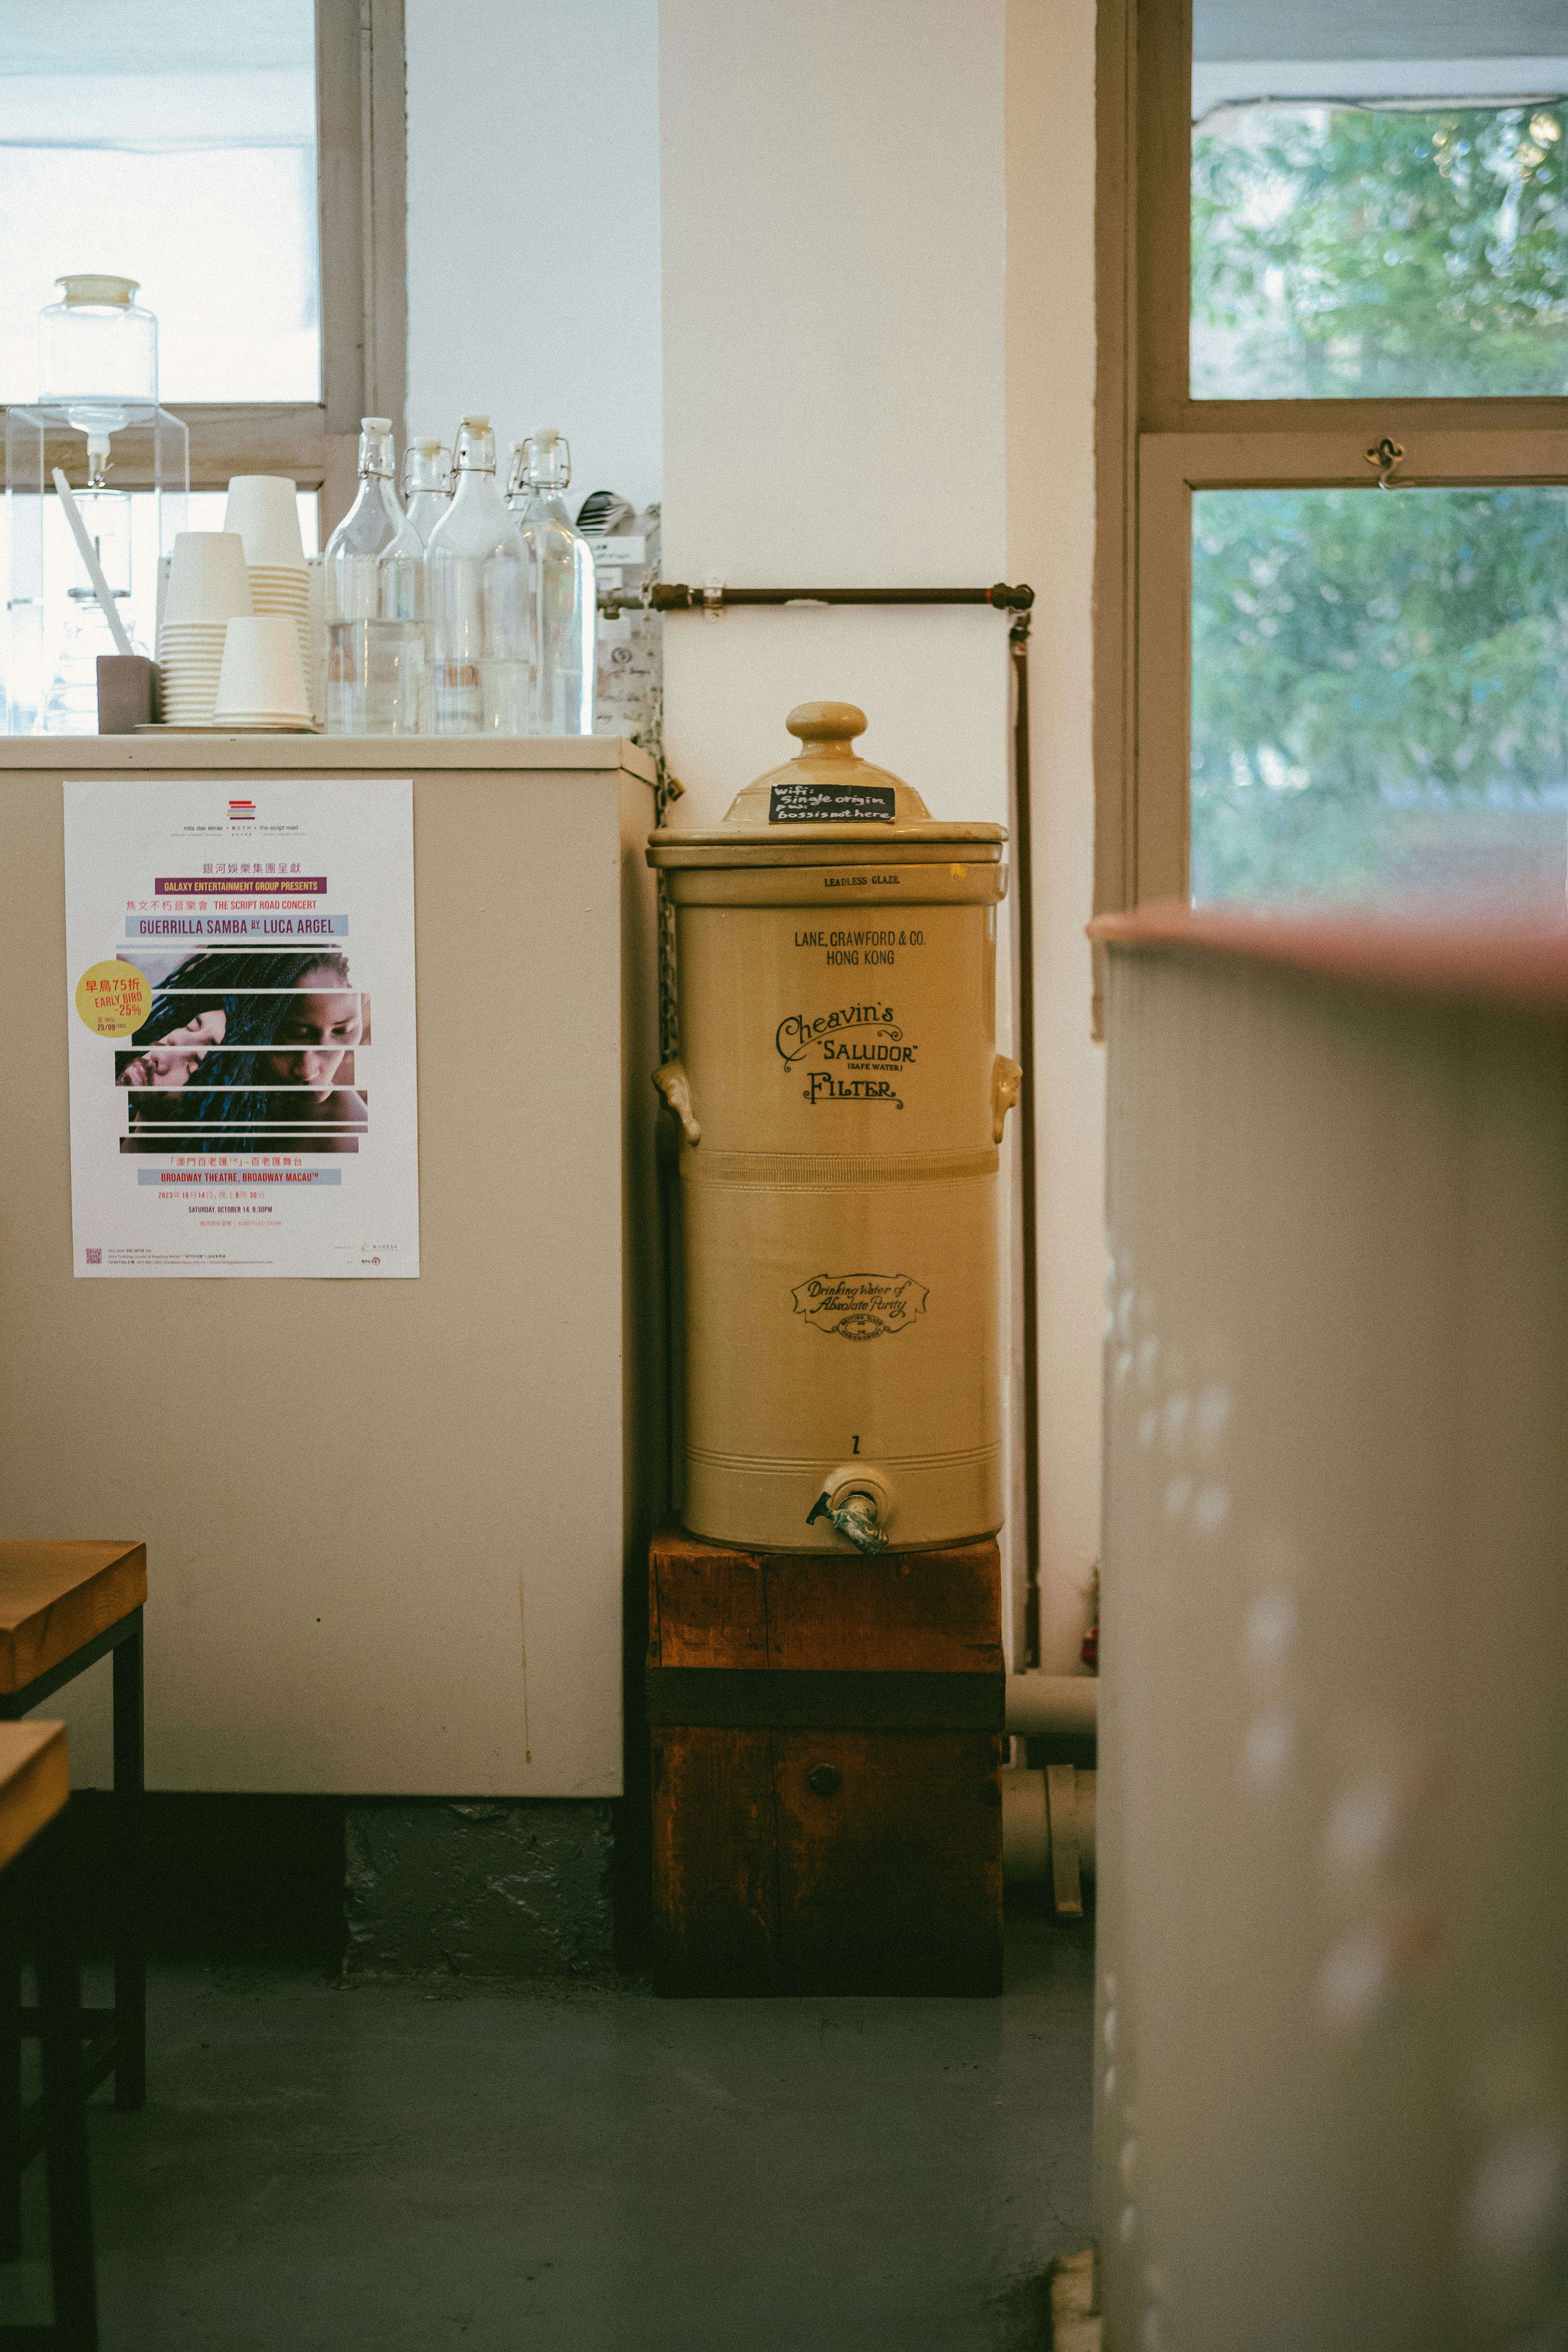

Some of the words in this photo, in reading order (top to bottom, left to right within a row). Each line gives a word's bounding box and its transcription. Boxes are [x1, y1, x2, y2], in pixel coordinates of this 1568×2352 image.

[835, 795, 886, 805] origin
[164, 882, 192, 892] GALAXY
[194, 882, 253, 891] ENTERTAINMENT
[255, 882, 279, 891] GROUP
[281, 881, 318, 891] PRESENTS
[824, 876, 867, 887] LEADLESS
[871, 875, 900, 884] GLAZE
[214, 900, 228, 910] THE
[231, 900, 257, 910] SCRIPT
[259, 900, 280, 910] ROAD
[282, 900, 317, 910] CONCERT
[139, 919, 203, 934] GUERRILLA
[207, 919, 247, 934] SAMBA
[251, 919, 260, 929] BY
[264, 919, 293, 934] LUCA
[297, 919, 334, 934] ARGEL
[829, 931, 895, 947] CRAWFORD
[898, 930, 907, 946] &
[827, 950, 859, 965] HONG
[864, 949, 895, 964] KONG
[94, 994, 120, 1009] EARLY
[122, 991, 142, 1004] BIRD
[115, 1004, 142, 1017] -25%
[776, 1002, 893, 1062] Cheavin's
[161, 1173, 202, 1182] BROADWAY
[205, 1172, 240, 1183] THEATRE,
[242, 1172, 283, 1182] BROADWAY
[808, 1281, 858, 1298] Drinking
[860, 1282, 891, 1295] Water
[894, 1281, 912, 1298] of
[809, 1296, 869, 1314] Absolute
[870, 1296, 907, 1318] Purity
